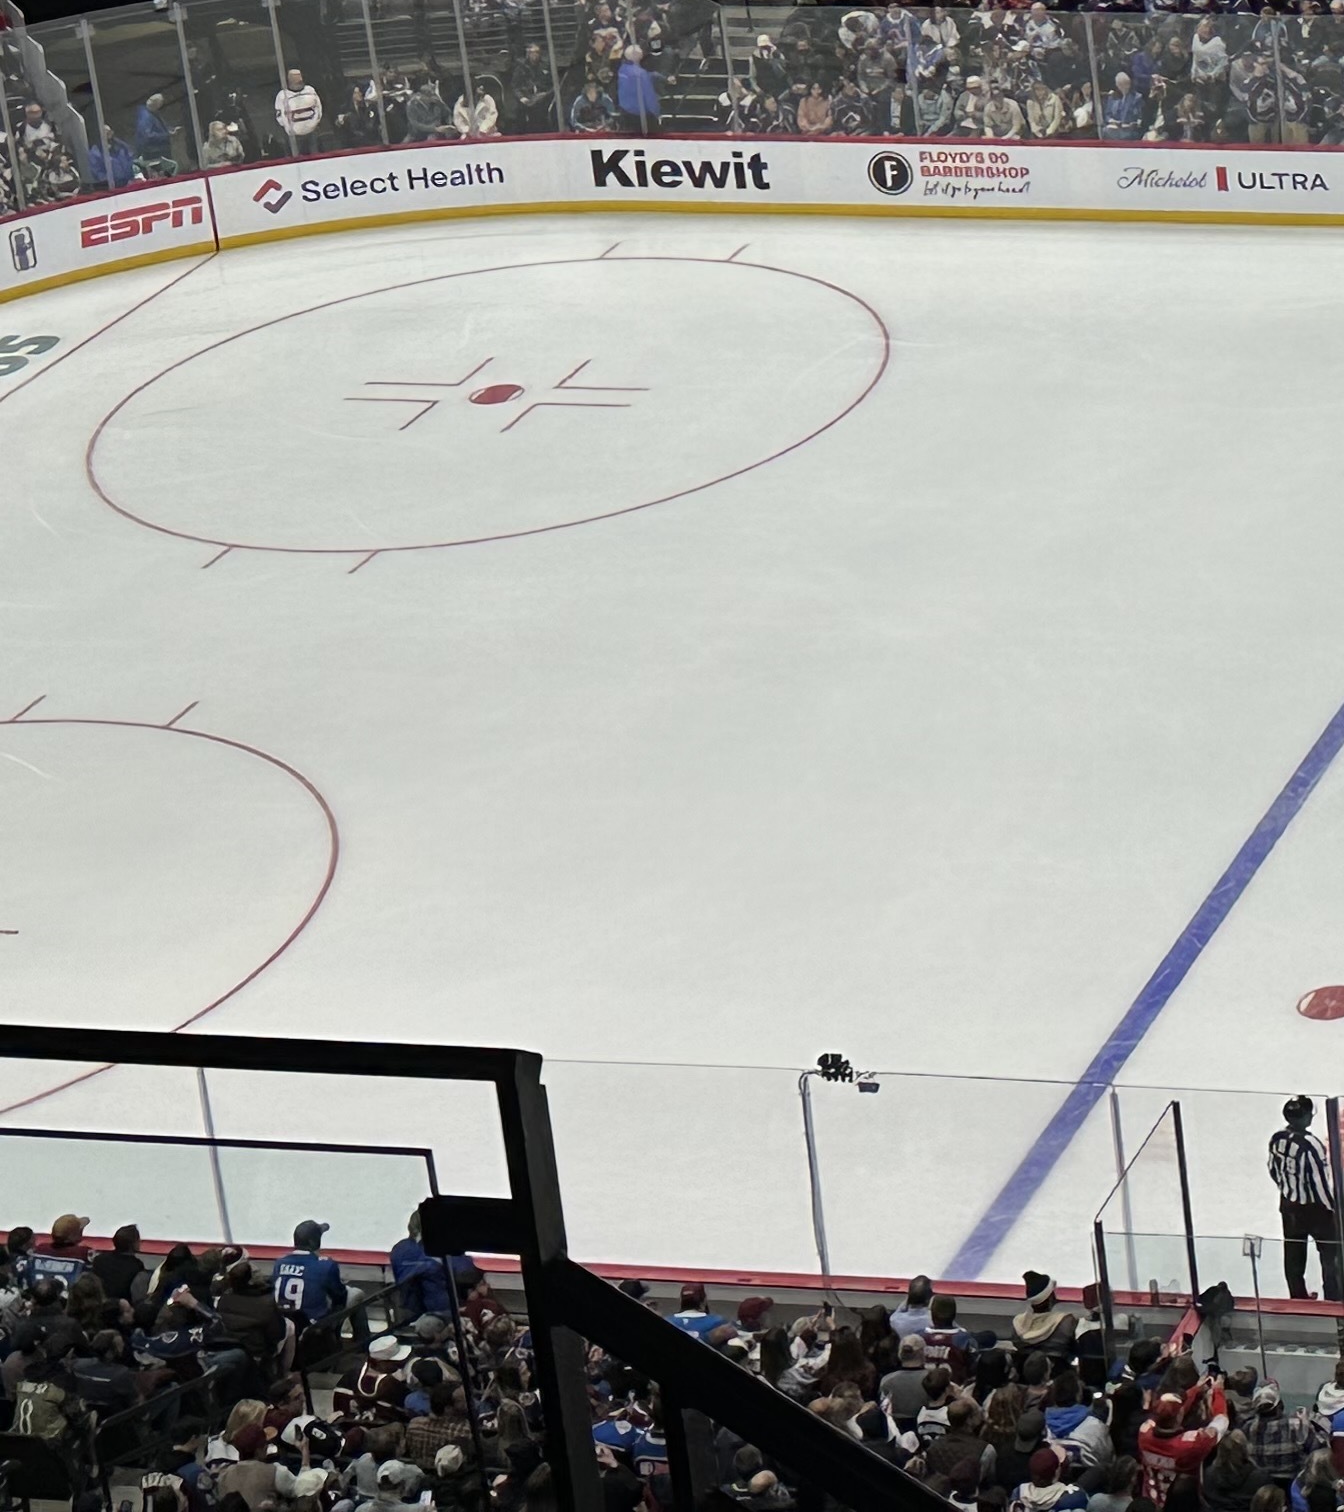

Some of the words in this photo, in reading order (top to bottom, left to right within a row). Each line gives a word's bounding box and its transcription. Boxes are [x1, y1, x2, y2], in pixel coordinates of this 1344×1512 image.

[301, 172, 400, 203] Select
[406, 162, 505, 190] Health
[590, 148, 771, 190] Kiewit
[1237, 172, 1330, 191] ULTRA
[80, 195, 203, 249] ESPN
[274, 1277, 304, 1311] 19
